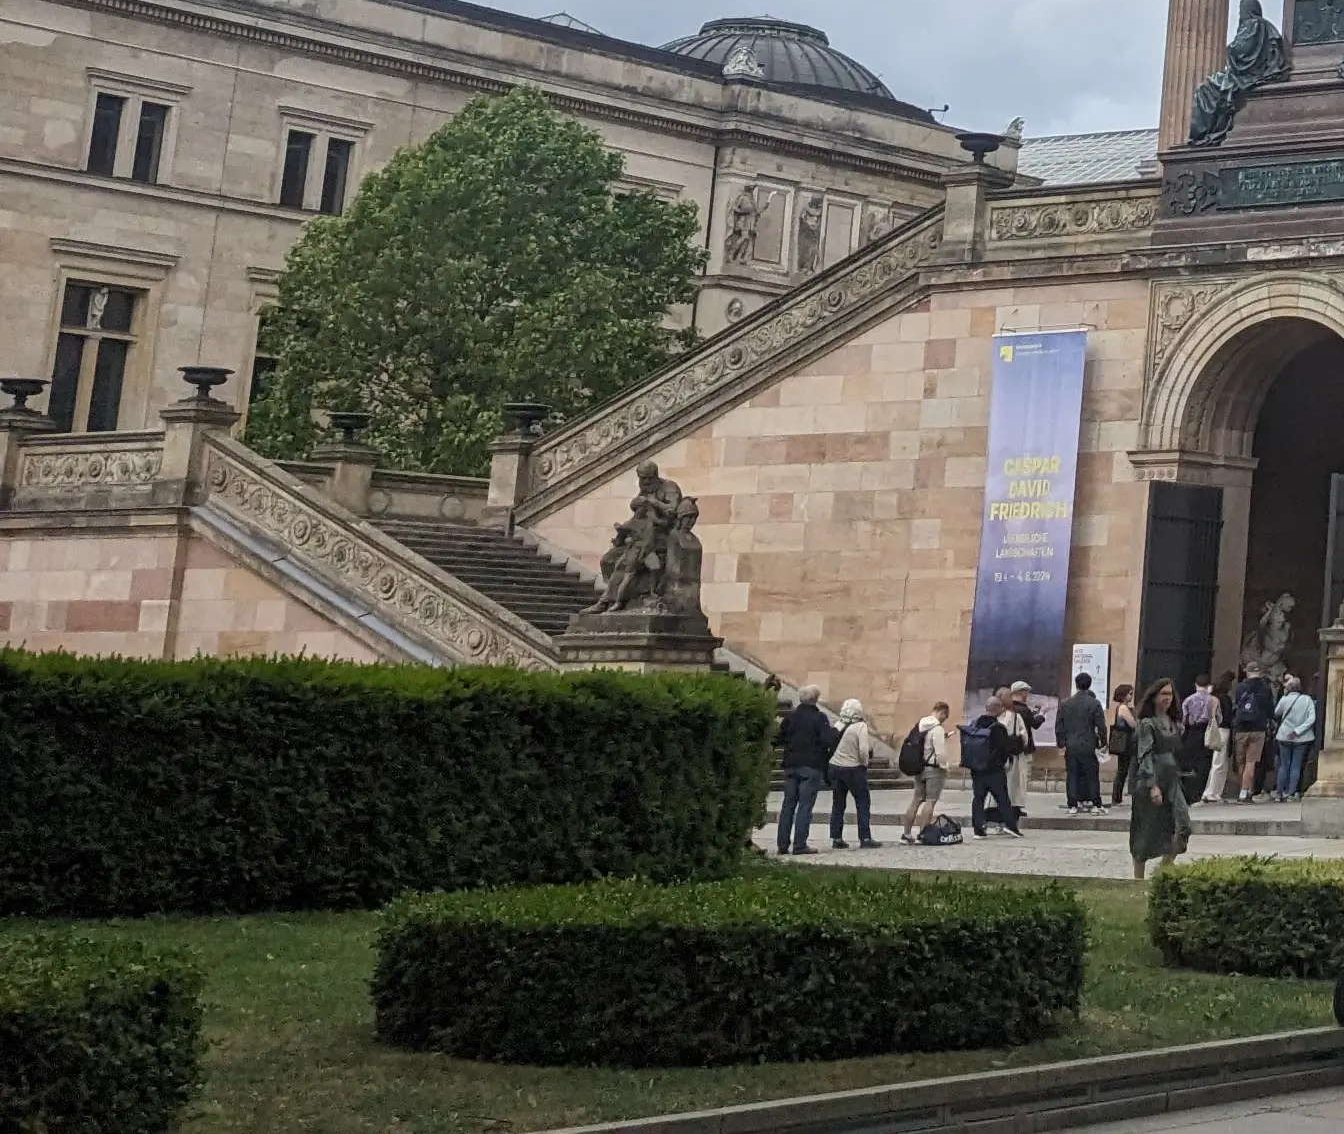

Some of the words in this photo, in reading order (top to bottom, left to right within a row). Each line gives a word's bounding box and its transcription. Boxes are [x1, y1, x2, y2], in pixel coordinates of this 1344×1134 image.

[1004, 456, 1060, 476] CASPAR
[1009, 479, 1051, 498] DAVID
[989, 501, 1068, 521] FRIEDRICH
